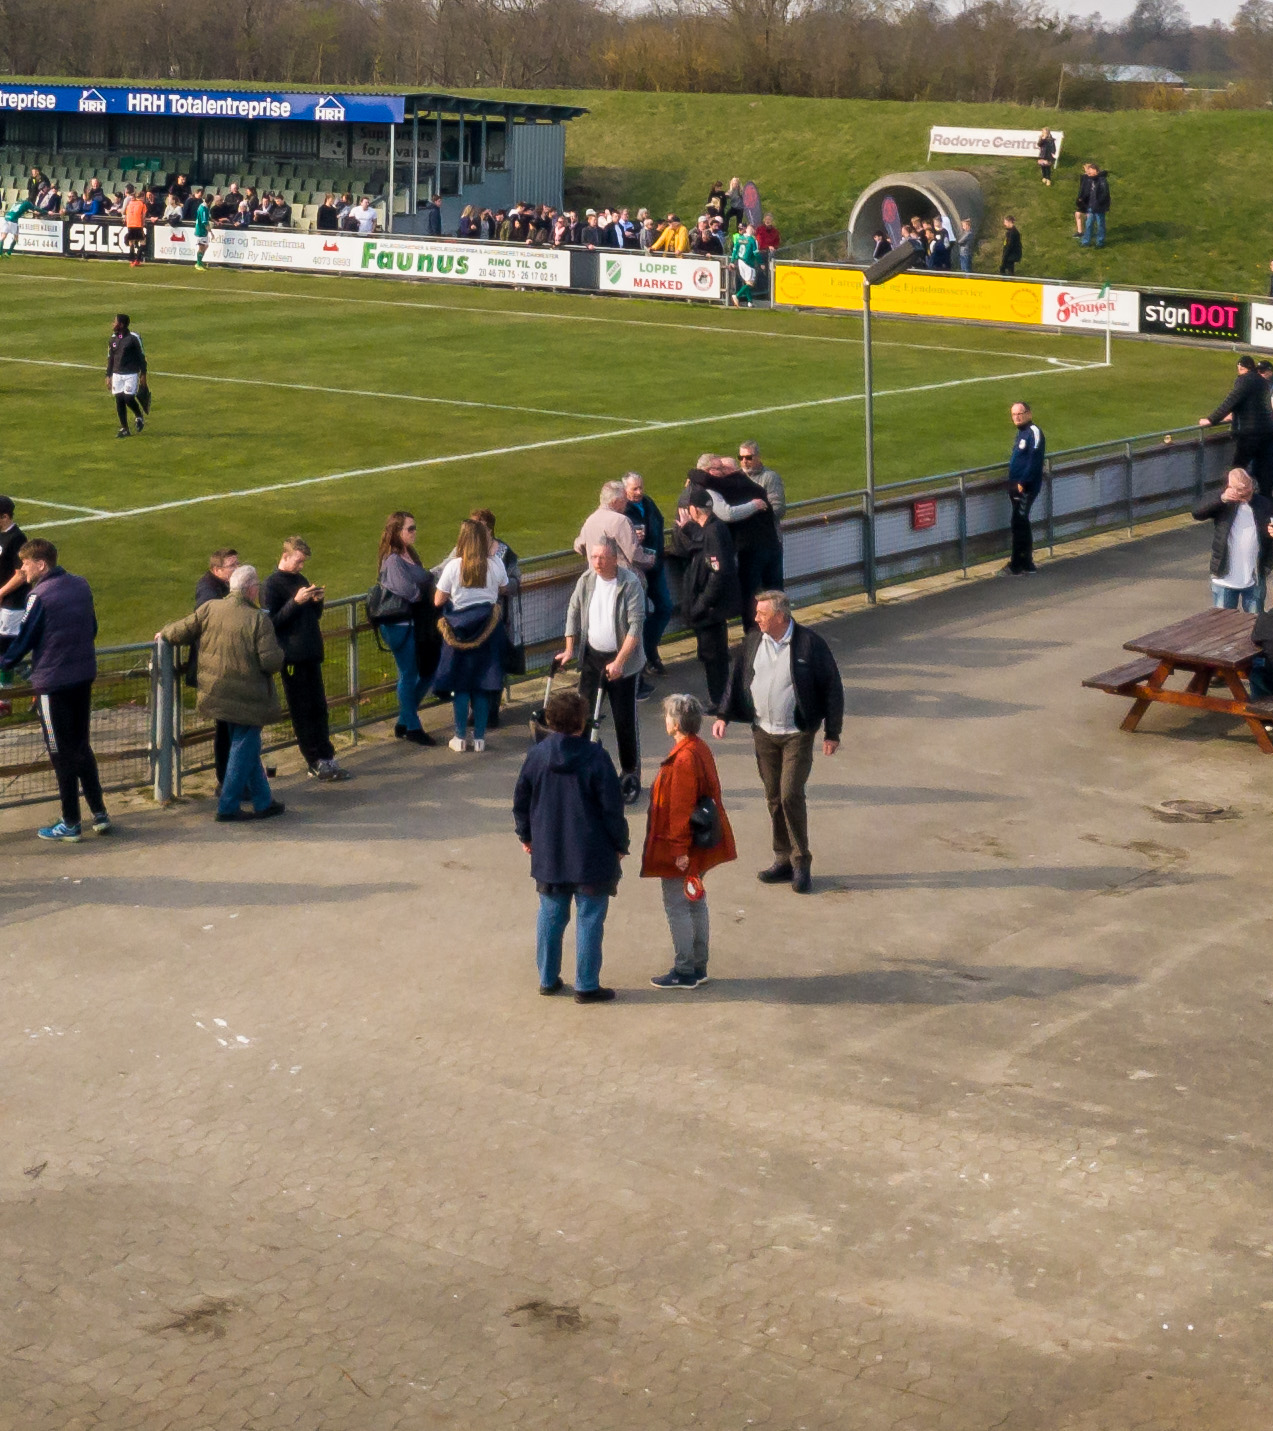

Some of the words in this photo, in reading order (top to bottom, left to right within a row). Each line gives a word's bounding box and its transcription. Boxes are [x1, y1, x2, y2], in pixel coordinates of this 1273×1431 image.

[79, 101, 106, 112] HRH
[128, 93, 165, 113] HRH
[168, 94, 291, 118] Totalentreprise
[314, 108, 345, 121] HRH
[362, 142, 381, 156] for
[992, 136, 1041, 150] Centru
[237, 237, 249, 248] og
[224, 249, 245, 260] John
[261, 251, 293, 263] Nielsen
[361, 241, 469, 275] Faunus
[488, 257, 511, 268] RING
[516, 259, 531, 269] TIL
[534, 260, 548, 270] OS
[639, 262, 677, 275] LOPPE
[633, 277, 683, 291] MARKED
[1145, 301, 1238, 329] signDOT
